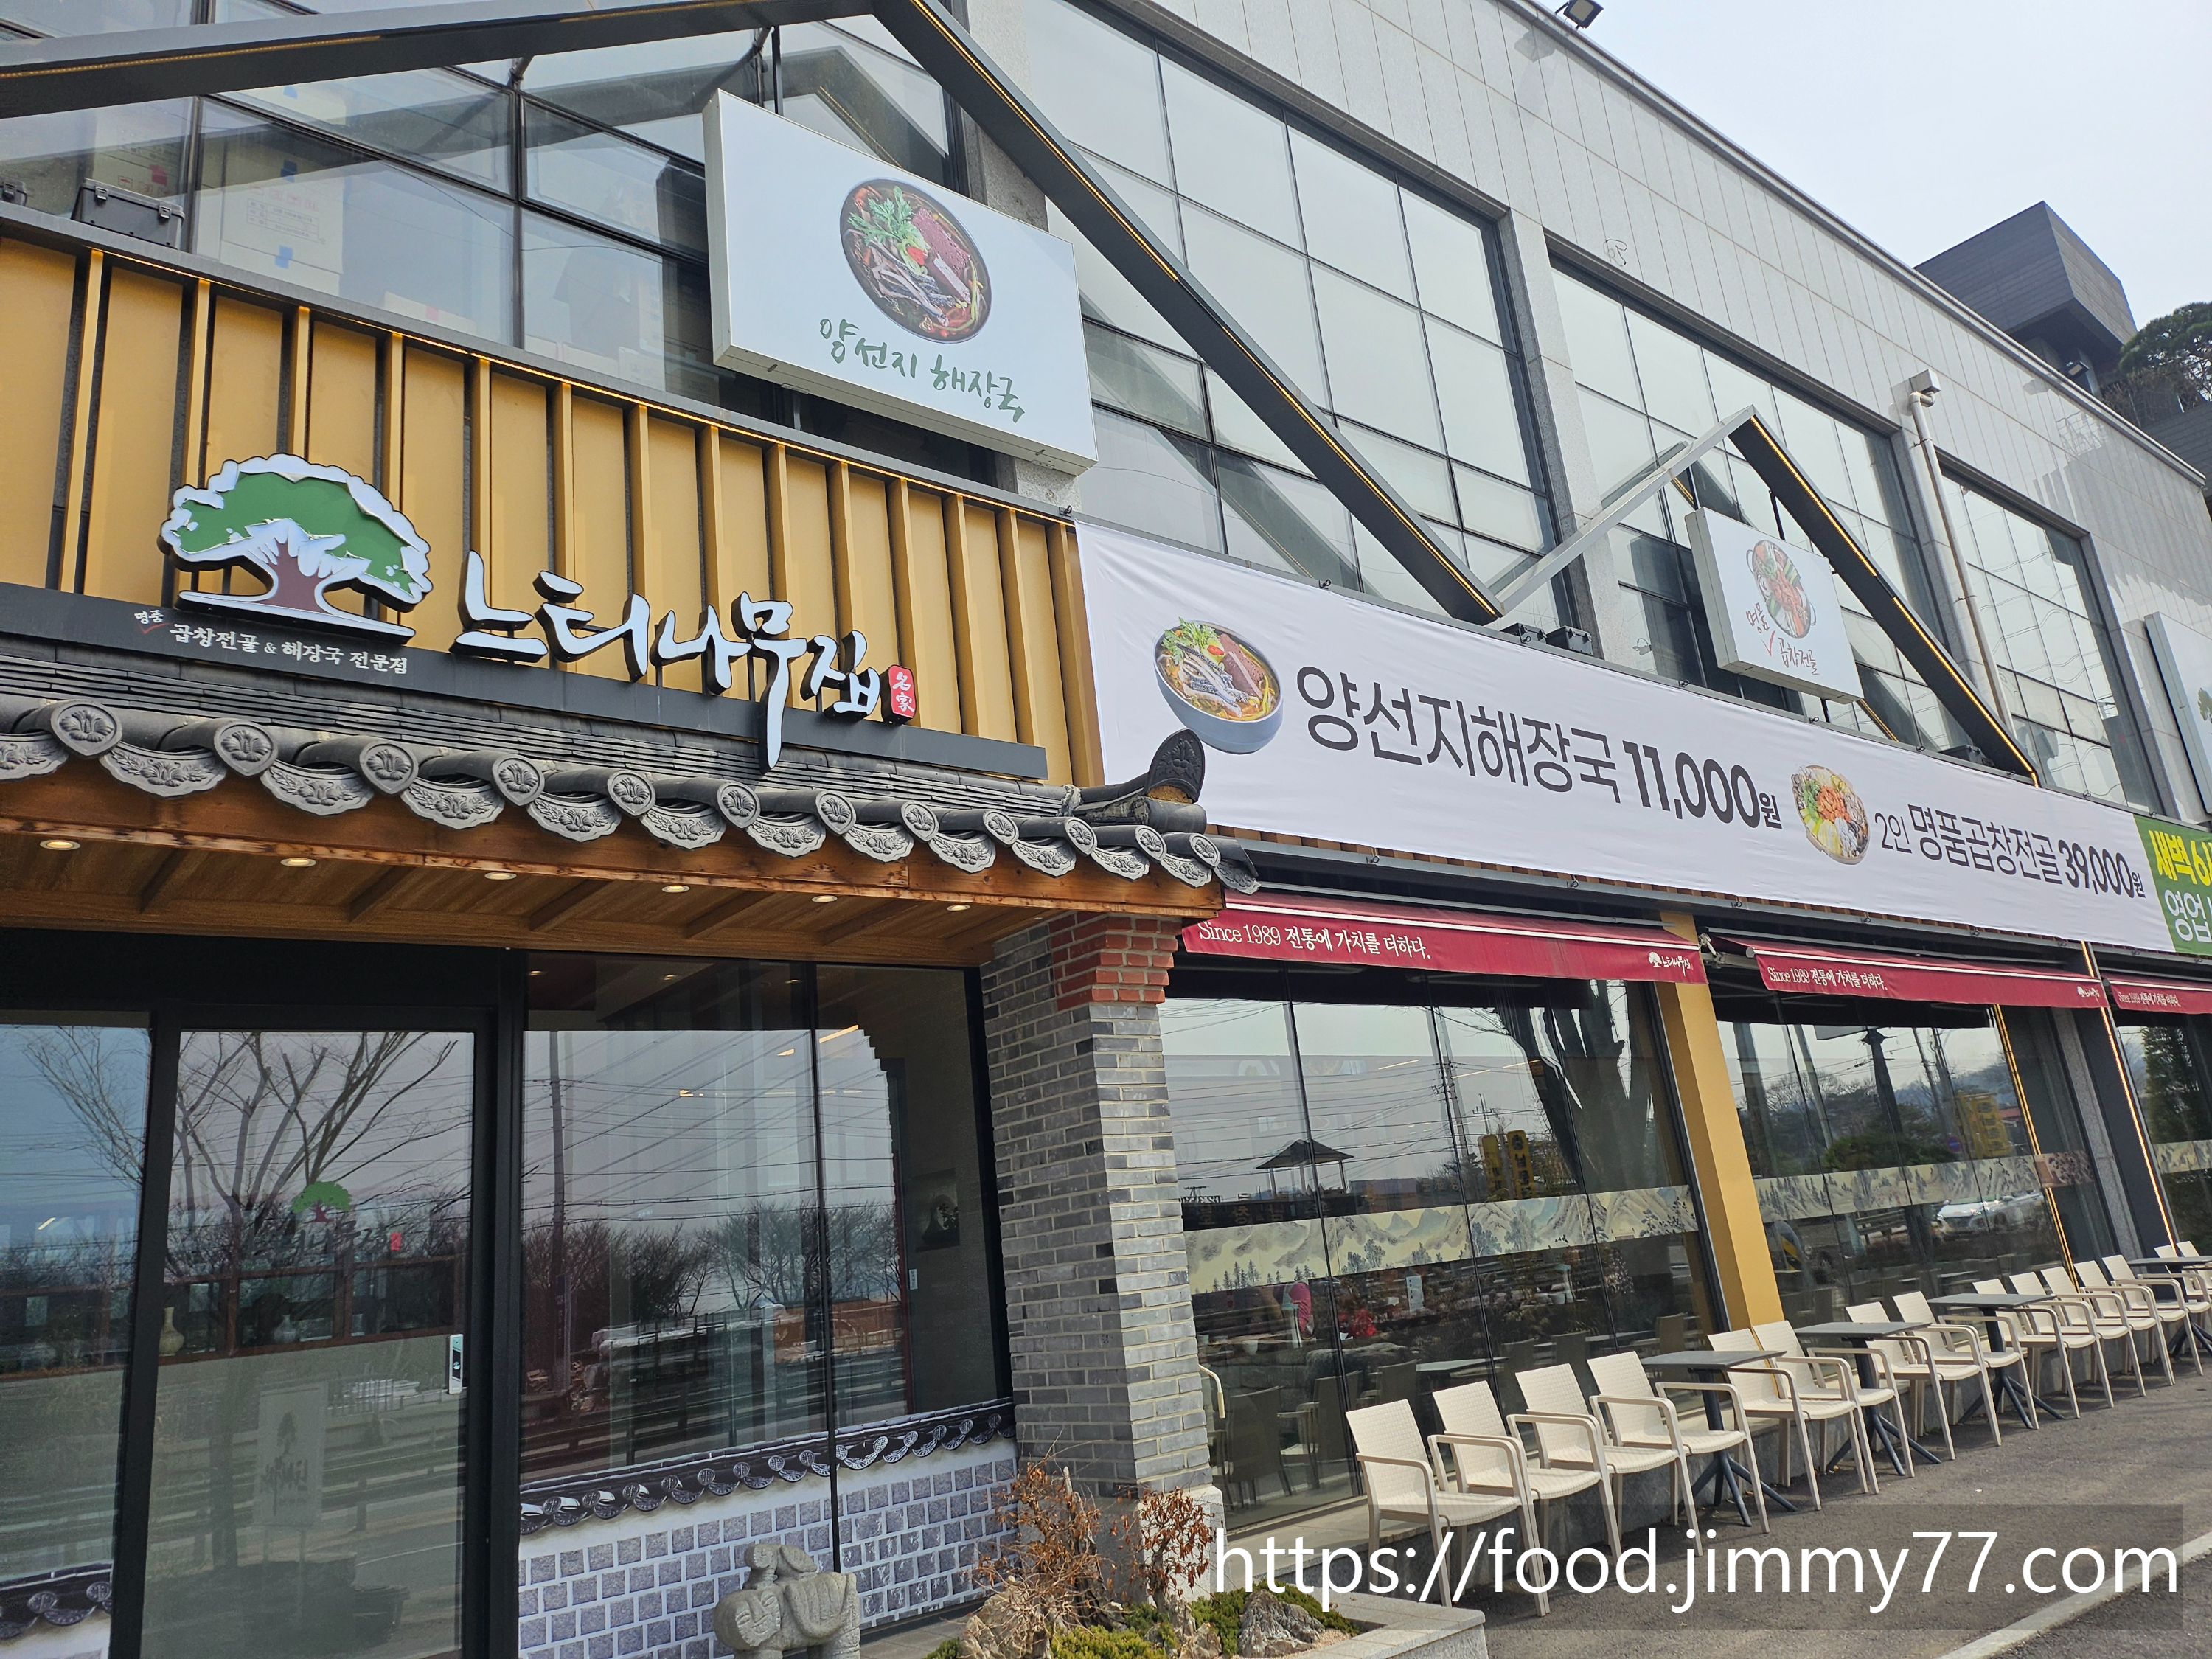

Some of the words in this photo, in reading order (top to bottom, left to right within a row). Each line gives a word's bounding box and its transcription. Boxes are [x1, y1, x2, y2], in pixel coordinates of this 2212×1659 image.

[819, 318, 917, 379] 양선지
[929, 354, 1025, 423] 해장국
[133, 610, 165, 625] 명품
[1745, 602, 1770, 634] 명품
[170, 623, 260, 654] 곱창전골
[264, 641, 278, 655] &
[282, 641, 344, 665] 해장국
[349, 652, 408, 675] 전문점
[1778, 636, 1820, 675] 곱창전골
[892, 672, 915, 713] 名家
[1296, 666, 1622, 804] 양선지해장국
[1623, 740, 1782, 830] 11,000원
[1874, 812, 1913, 854] 2인
[1907, 804, 2063, 885] 명품곱창전골
[2058, 839, 2146, 899] 39,000원
[2149, 830, 2198, 885] 새벽
[2165, 889, 2212, 942] 영업
[1197, 921, 1242, 942] Since
[1243, 924, 1281, 946] 1989
[1284, 925, 1333, 952] 전통에
[1335, 929, 1380, 955] 가치를
[1382, 933, 1431, 959] 더하다.
[1767, 967, 1791, 983] Since
[1790, 968, 1810, 984] 1989
[1810, 967, 1837, 987] 전통에
[1835, 970, 1861, 988] 가치를
[1860, 972, 1888, 991] 더하다.
